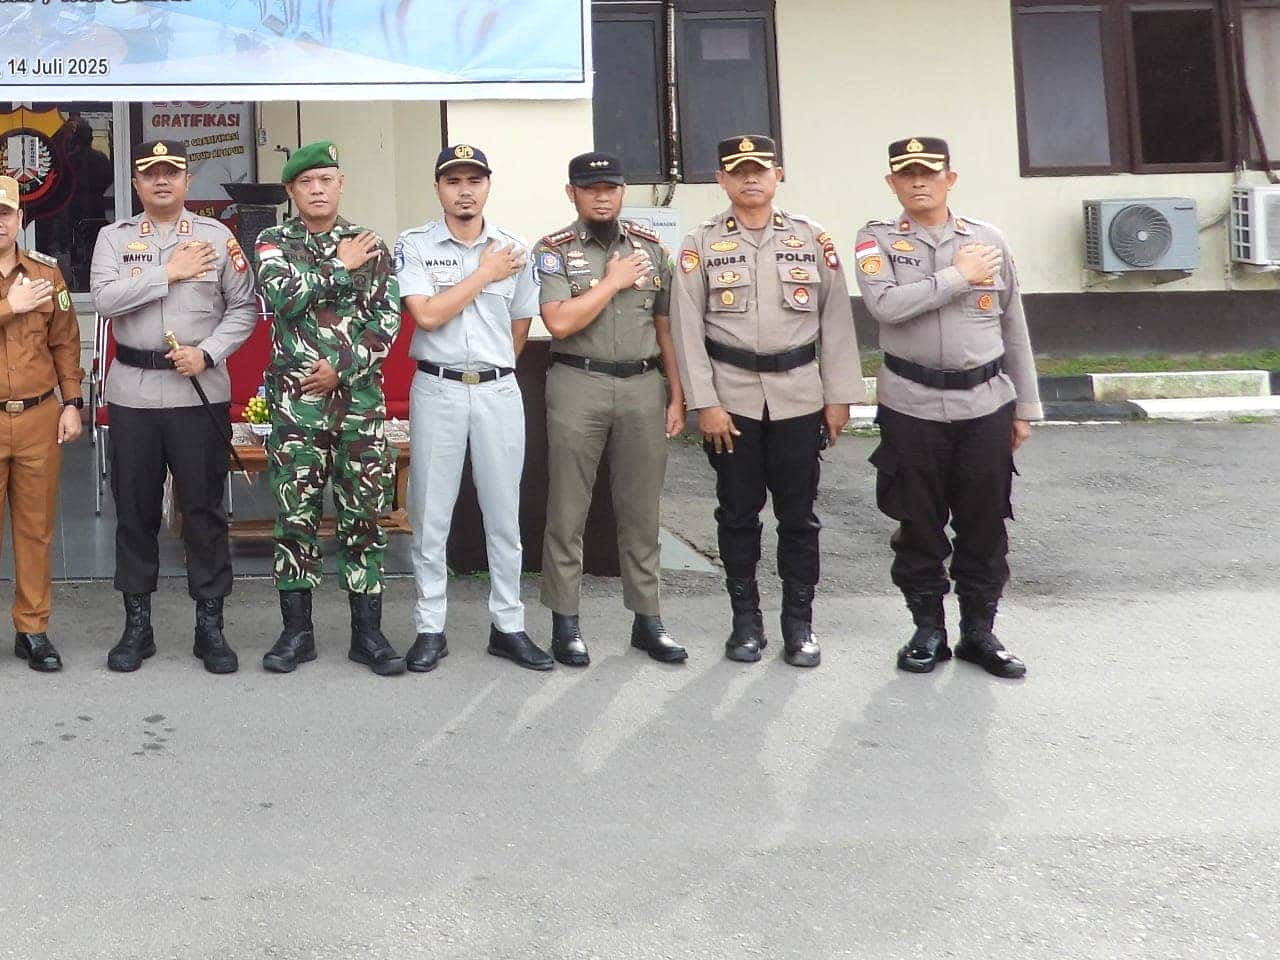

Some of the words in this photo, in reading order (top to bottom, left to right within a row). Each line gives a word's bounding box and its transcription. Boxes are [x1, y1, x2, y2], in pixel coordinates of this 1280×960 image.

[7, 58, 26, 75] 14
[32, 58, 62, 75] Juli
[68, 58, 108, 75] 2025
[151, 113, 240, 128] GRATIFIKASI
[123, 253, 153, 263] WAHYU
[424, 258, 458, 267] WANDA
[775, 252, 816, 263] POLRI
